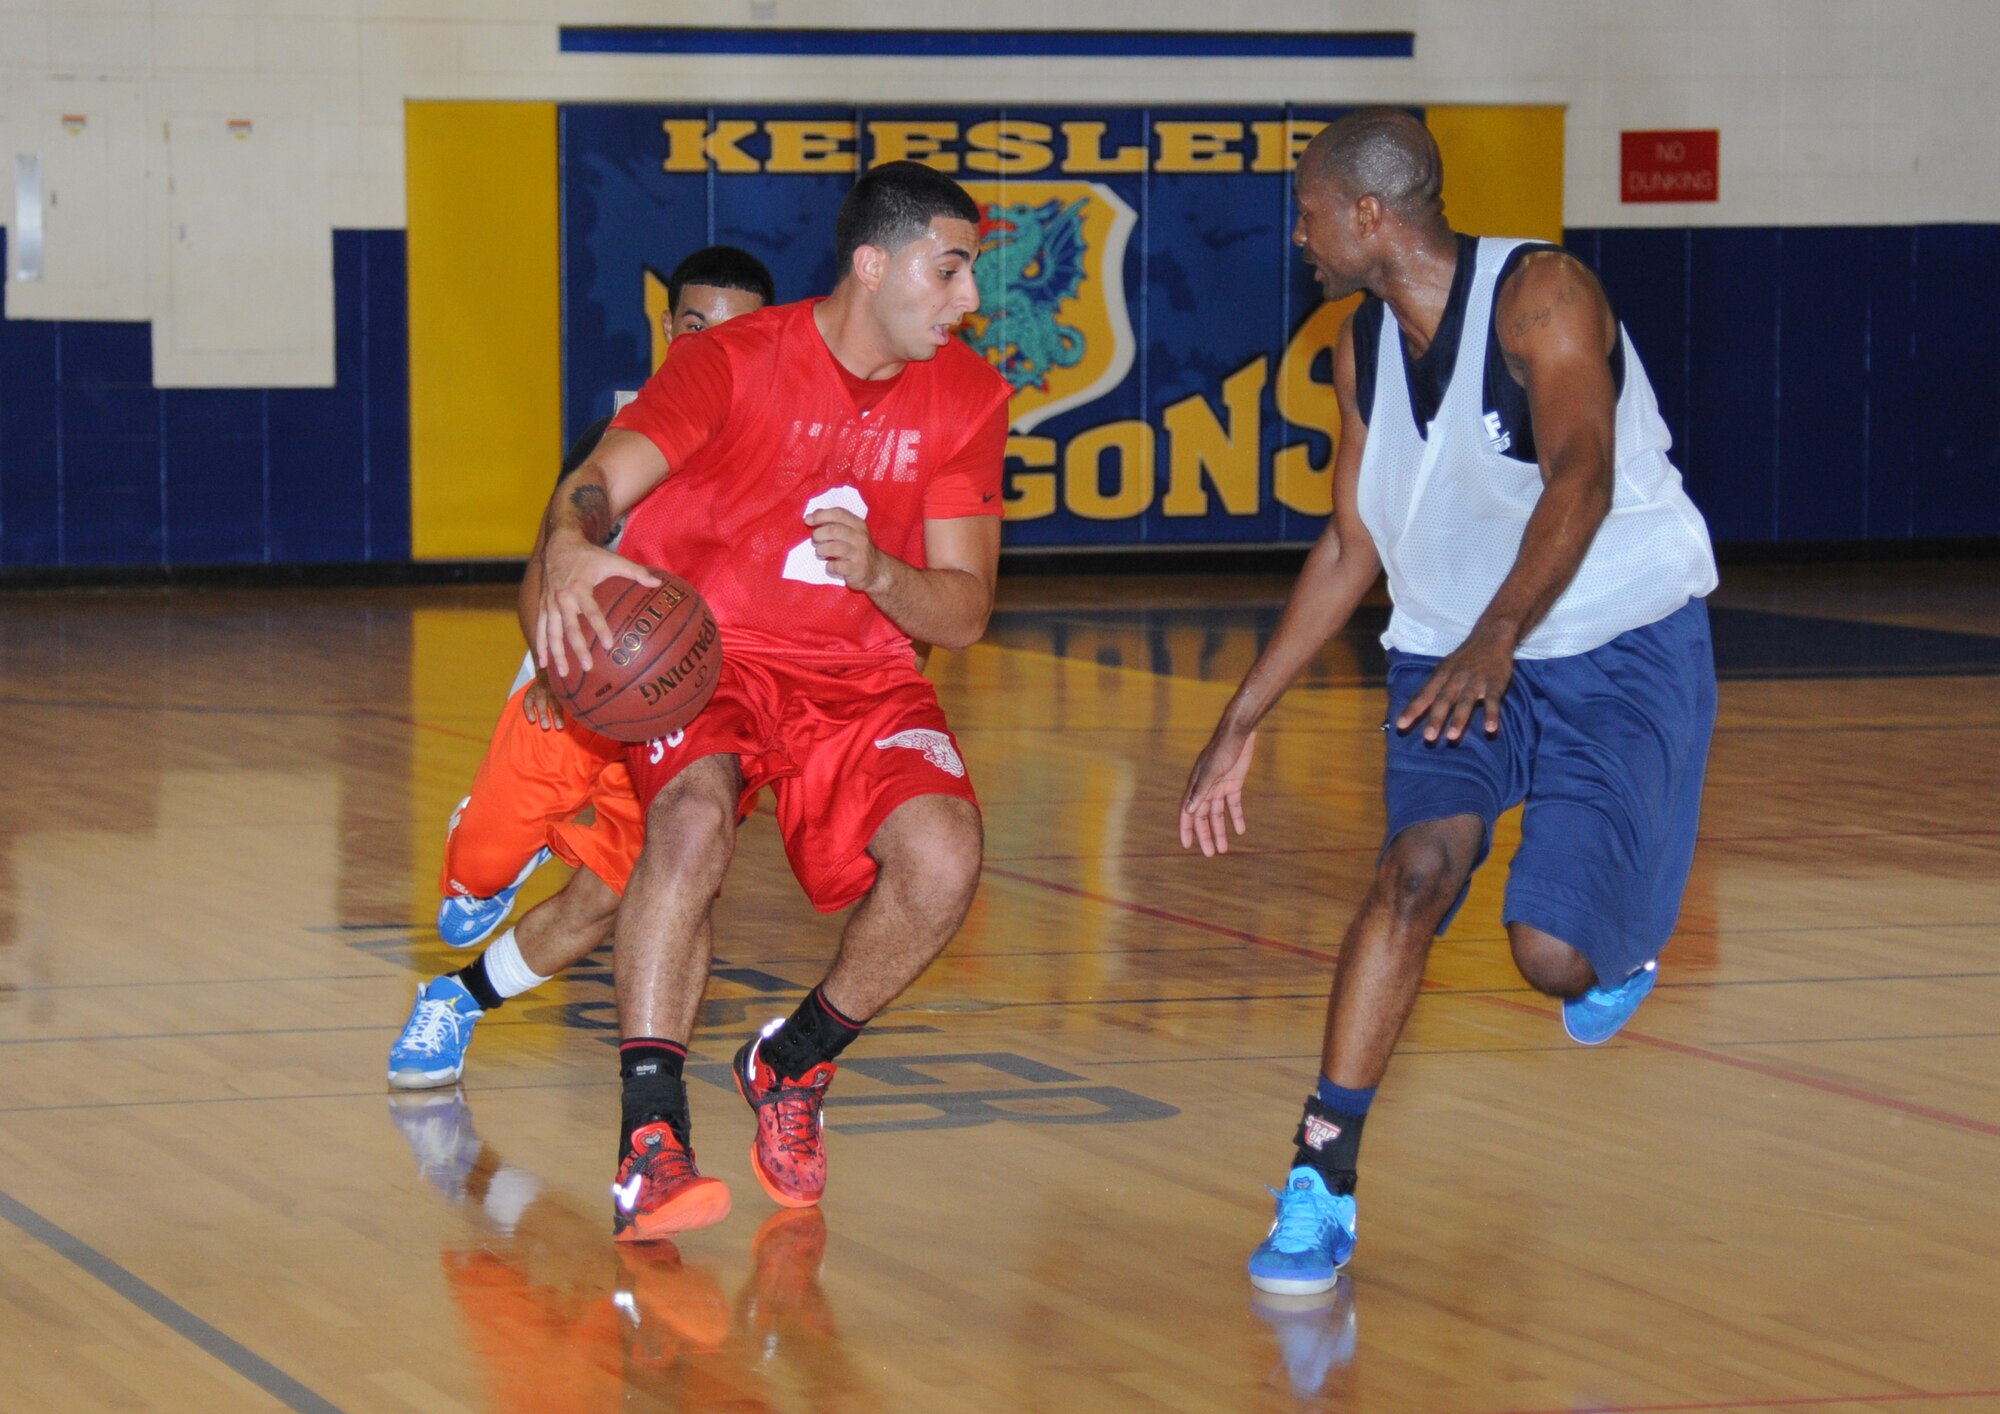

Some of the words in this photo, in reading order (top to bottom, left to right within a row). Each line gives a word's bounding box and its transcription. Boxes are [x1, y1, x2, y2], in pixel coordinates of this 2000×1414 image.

[1655, 141, 1686, 162] NO
[1628, 170, 1713, 192] DUNKING
[638, 611, 717, 706] SPALDING
